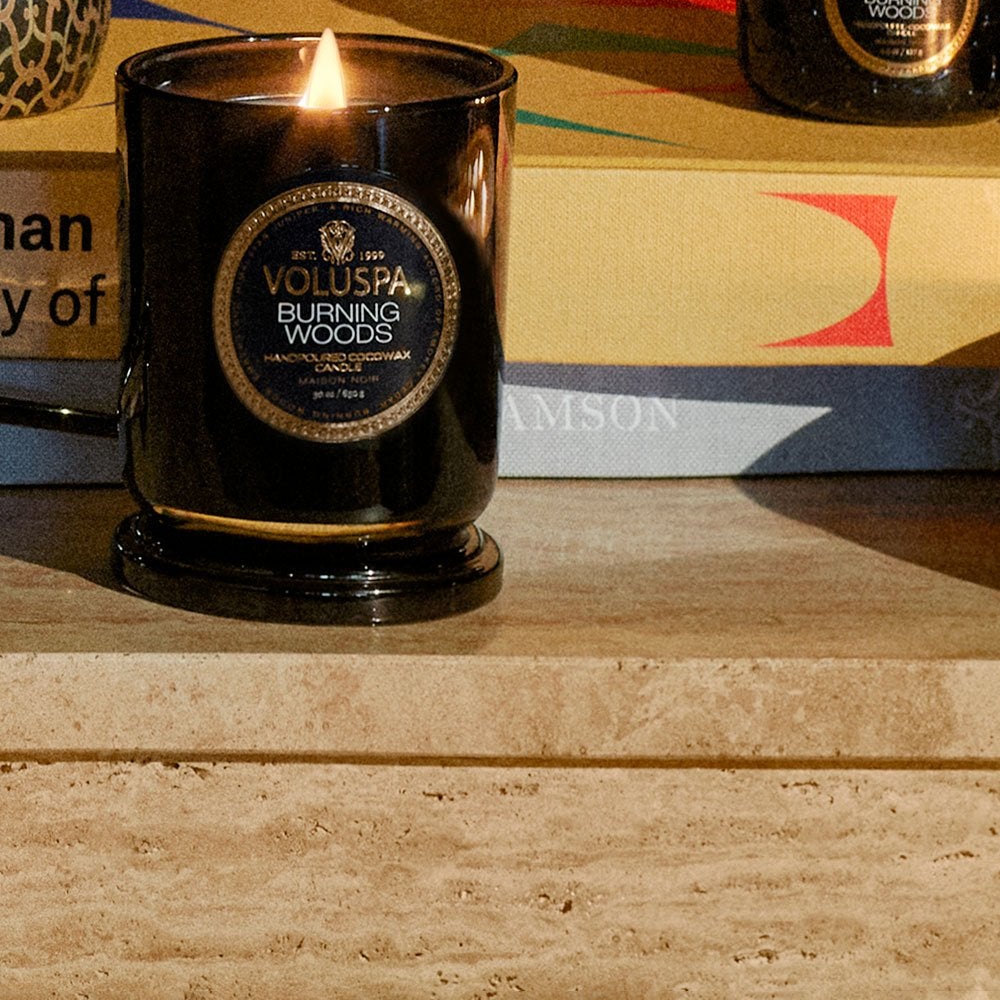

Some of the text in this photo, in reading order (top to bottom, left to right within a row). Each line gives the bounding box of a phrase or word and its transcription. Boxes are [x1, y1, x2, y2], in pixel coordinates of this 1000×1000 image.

[291, 250, 386, 261] EST. 1999
[262, 264, 411, 296] VOLUSPA
[49, 273, 106, 327] of
[278, 302, 400, 324] BURNING
[284, 323, 393, 345] WOODS
[314, 362, 362, 372] CANDLE
[351, 376, 380, 384] NOIR
